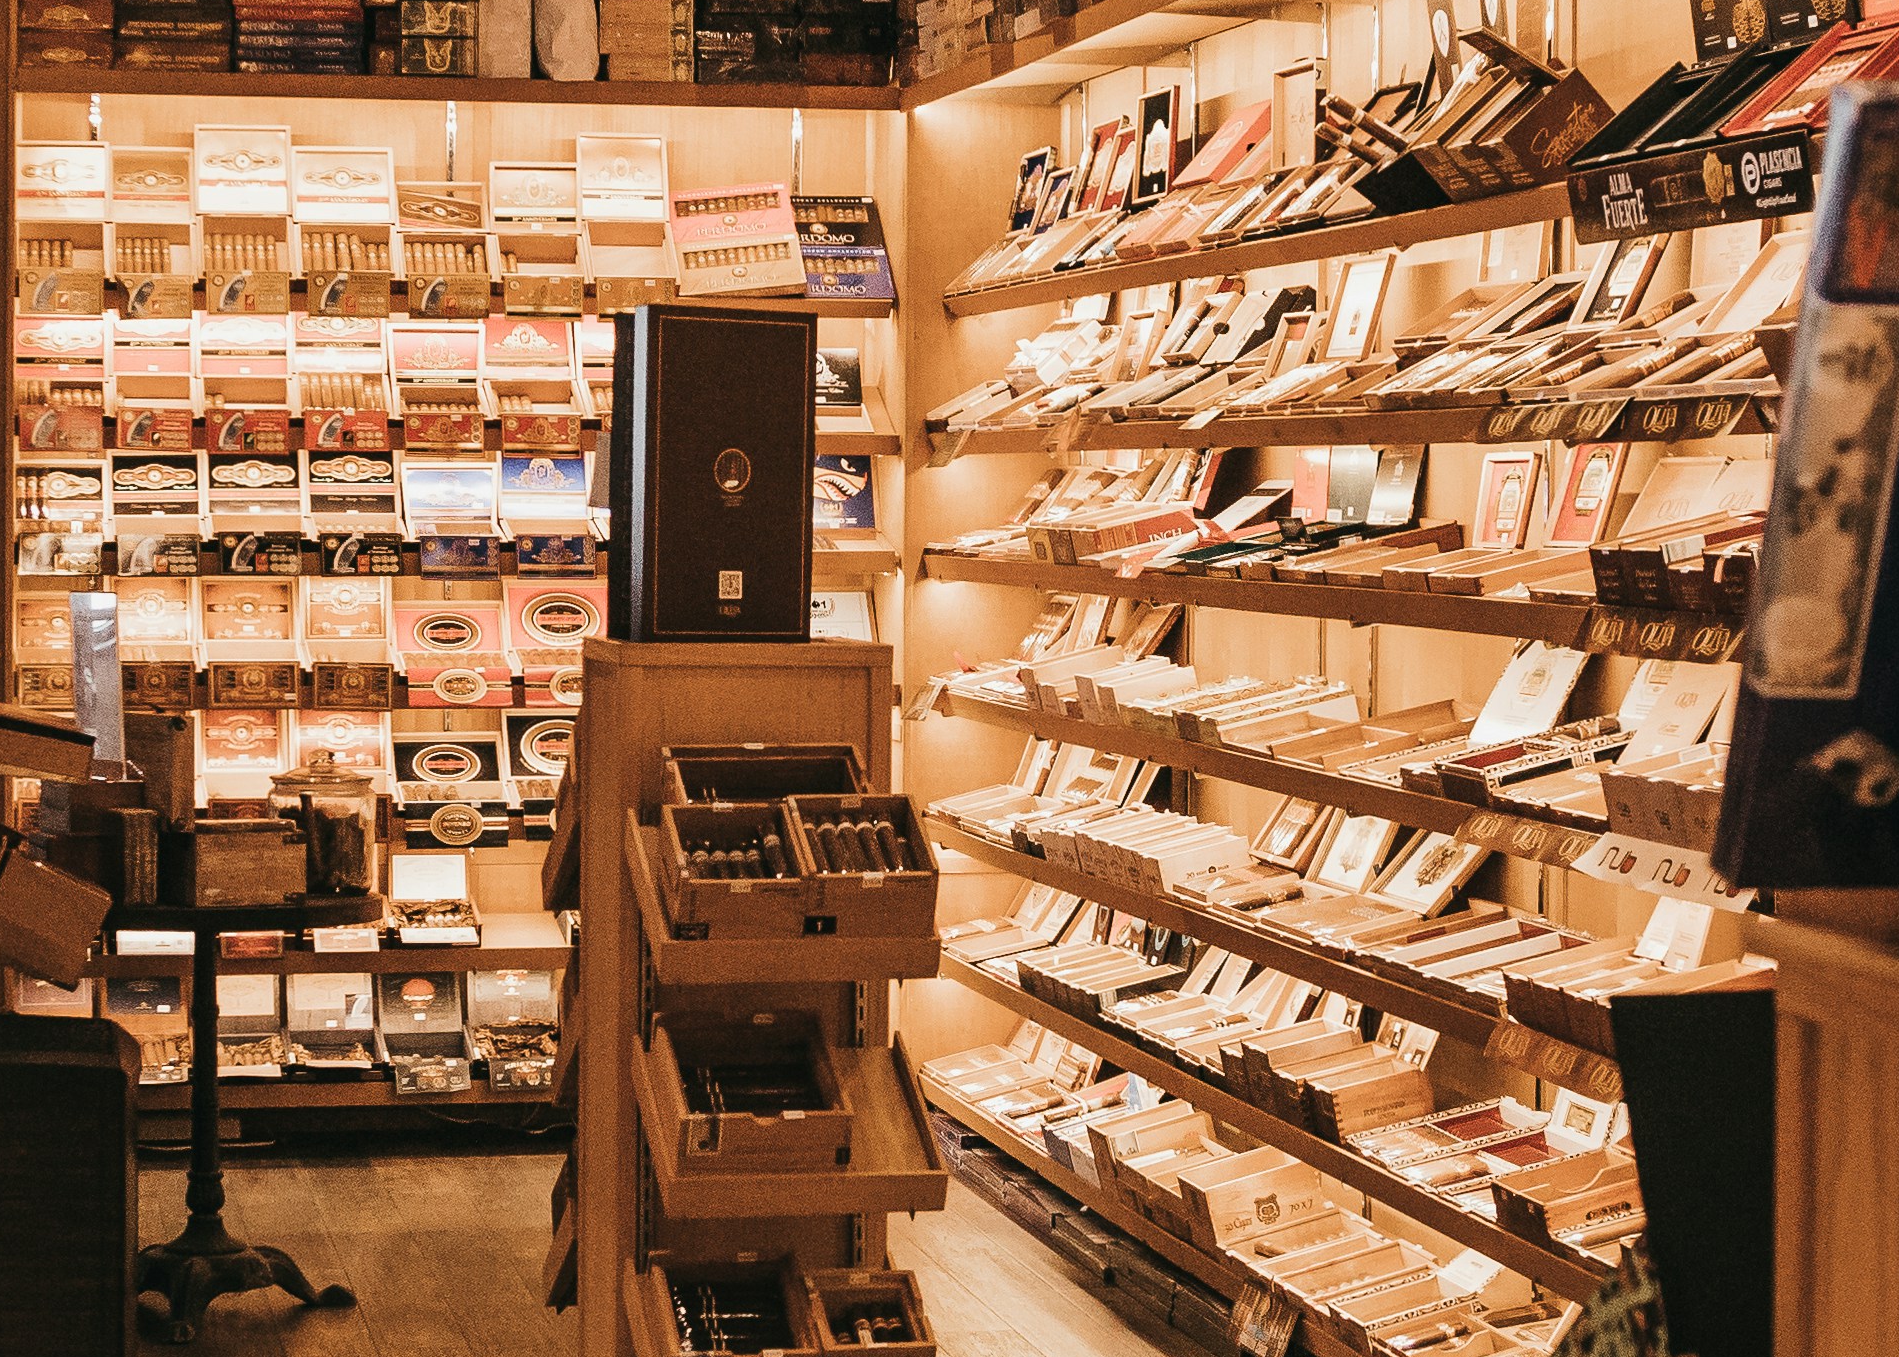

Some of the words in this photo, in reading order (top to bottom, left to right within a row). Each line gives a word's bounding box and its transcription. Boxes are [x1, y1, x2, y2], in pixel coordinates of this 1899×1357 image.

[1759, 146, 1804, 175] PLASENCIA
[1608, 172, 1633, 196] ALMA
[1602, 189, 1648, 231] FUERTE
[800, 233, 855, 245] RDOMO
[810, 284, 866, 294] RDOMO
[1148, 527, 1182, 545] INCH
